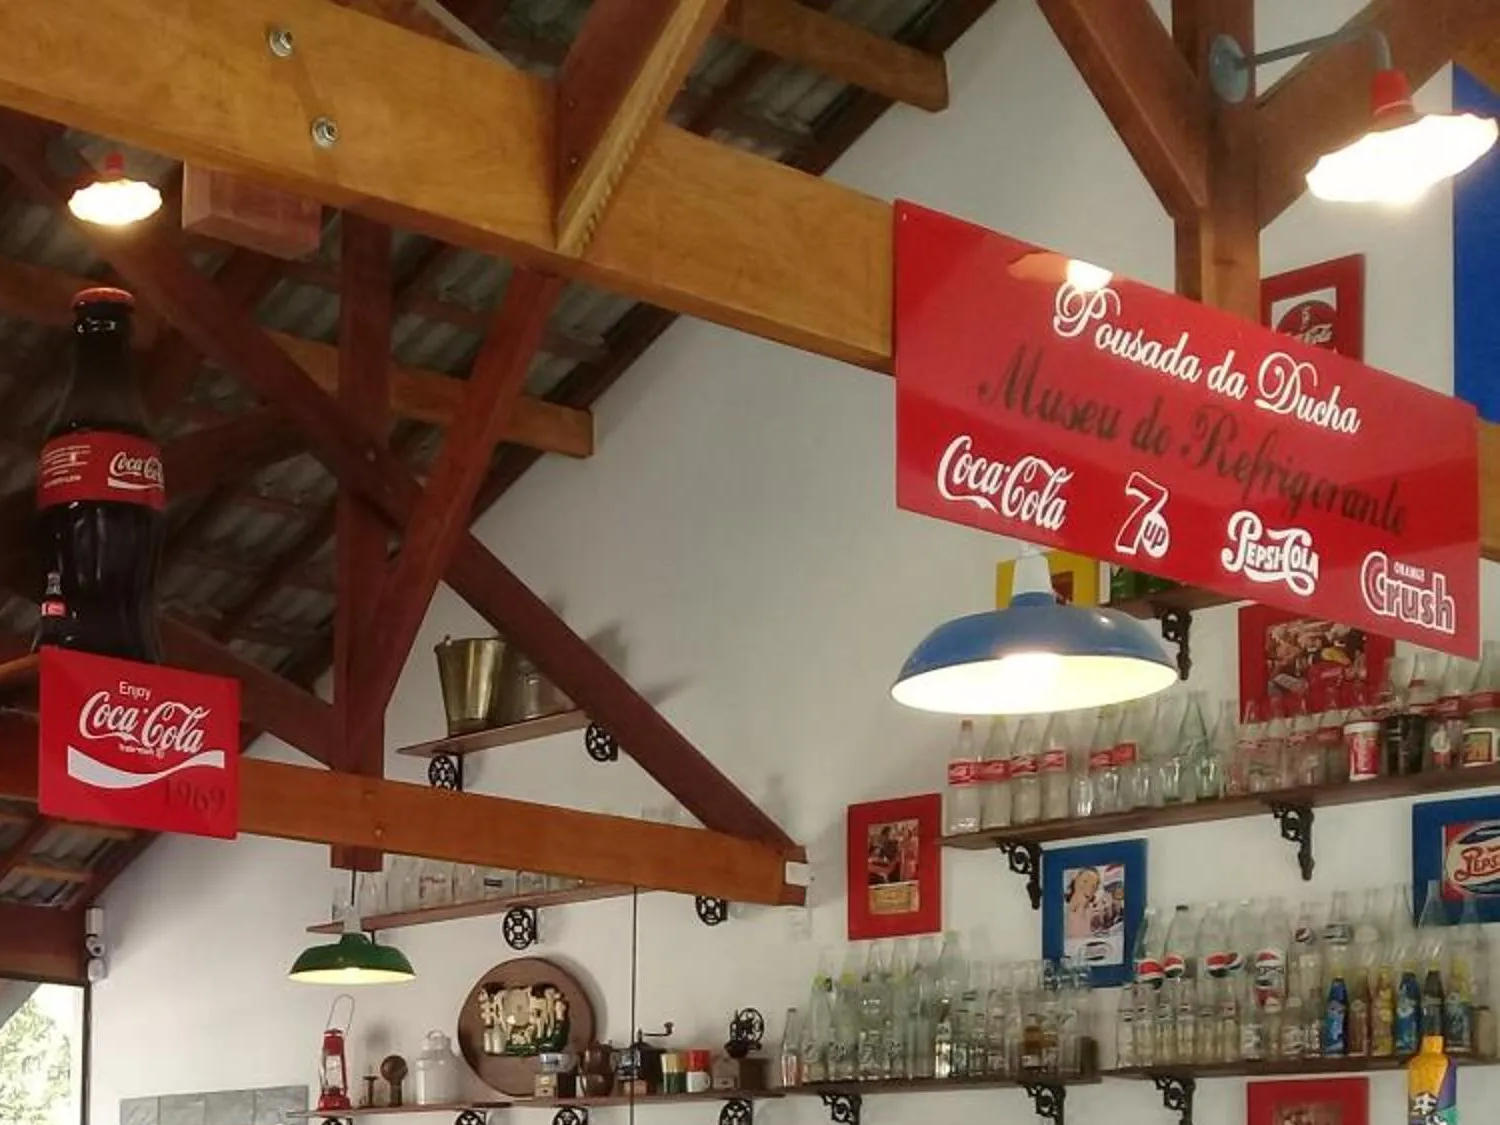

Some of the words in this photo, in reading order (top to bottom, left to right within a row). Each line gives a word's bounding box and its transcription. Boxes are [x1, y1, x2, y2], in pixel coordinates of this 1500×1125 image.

[1053, 280, 1202, 384] Pousada
[1206, 349, 1249, 401] da
[1254, 351, 1361, 434] Ducha
[977, 342, 1123, 441] Museu
[1179, 403, 1407, 536] Refrigerante
[1361, 551, 1455, 635] Crush
[79, 691, 213, 753] Coca-Cola
[118, 681, 151, 701] Enjoy
[163, 778, 228, 815] 1969
